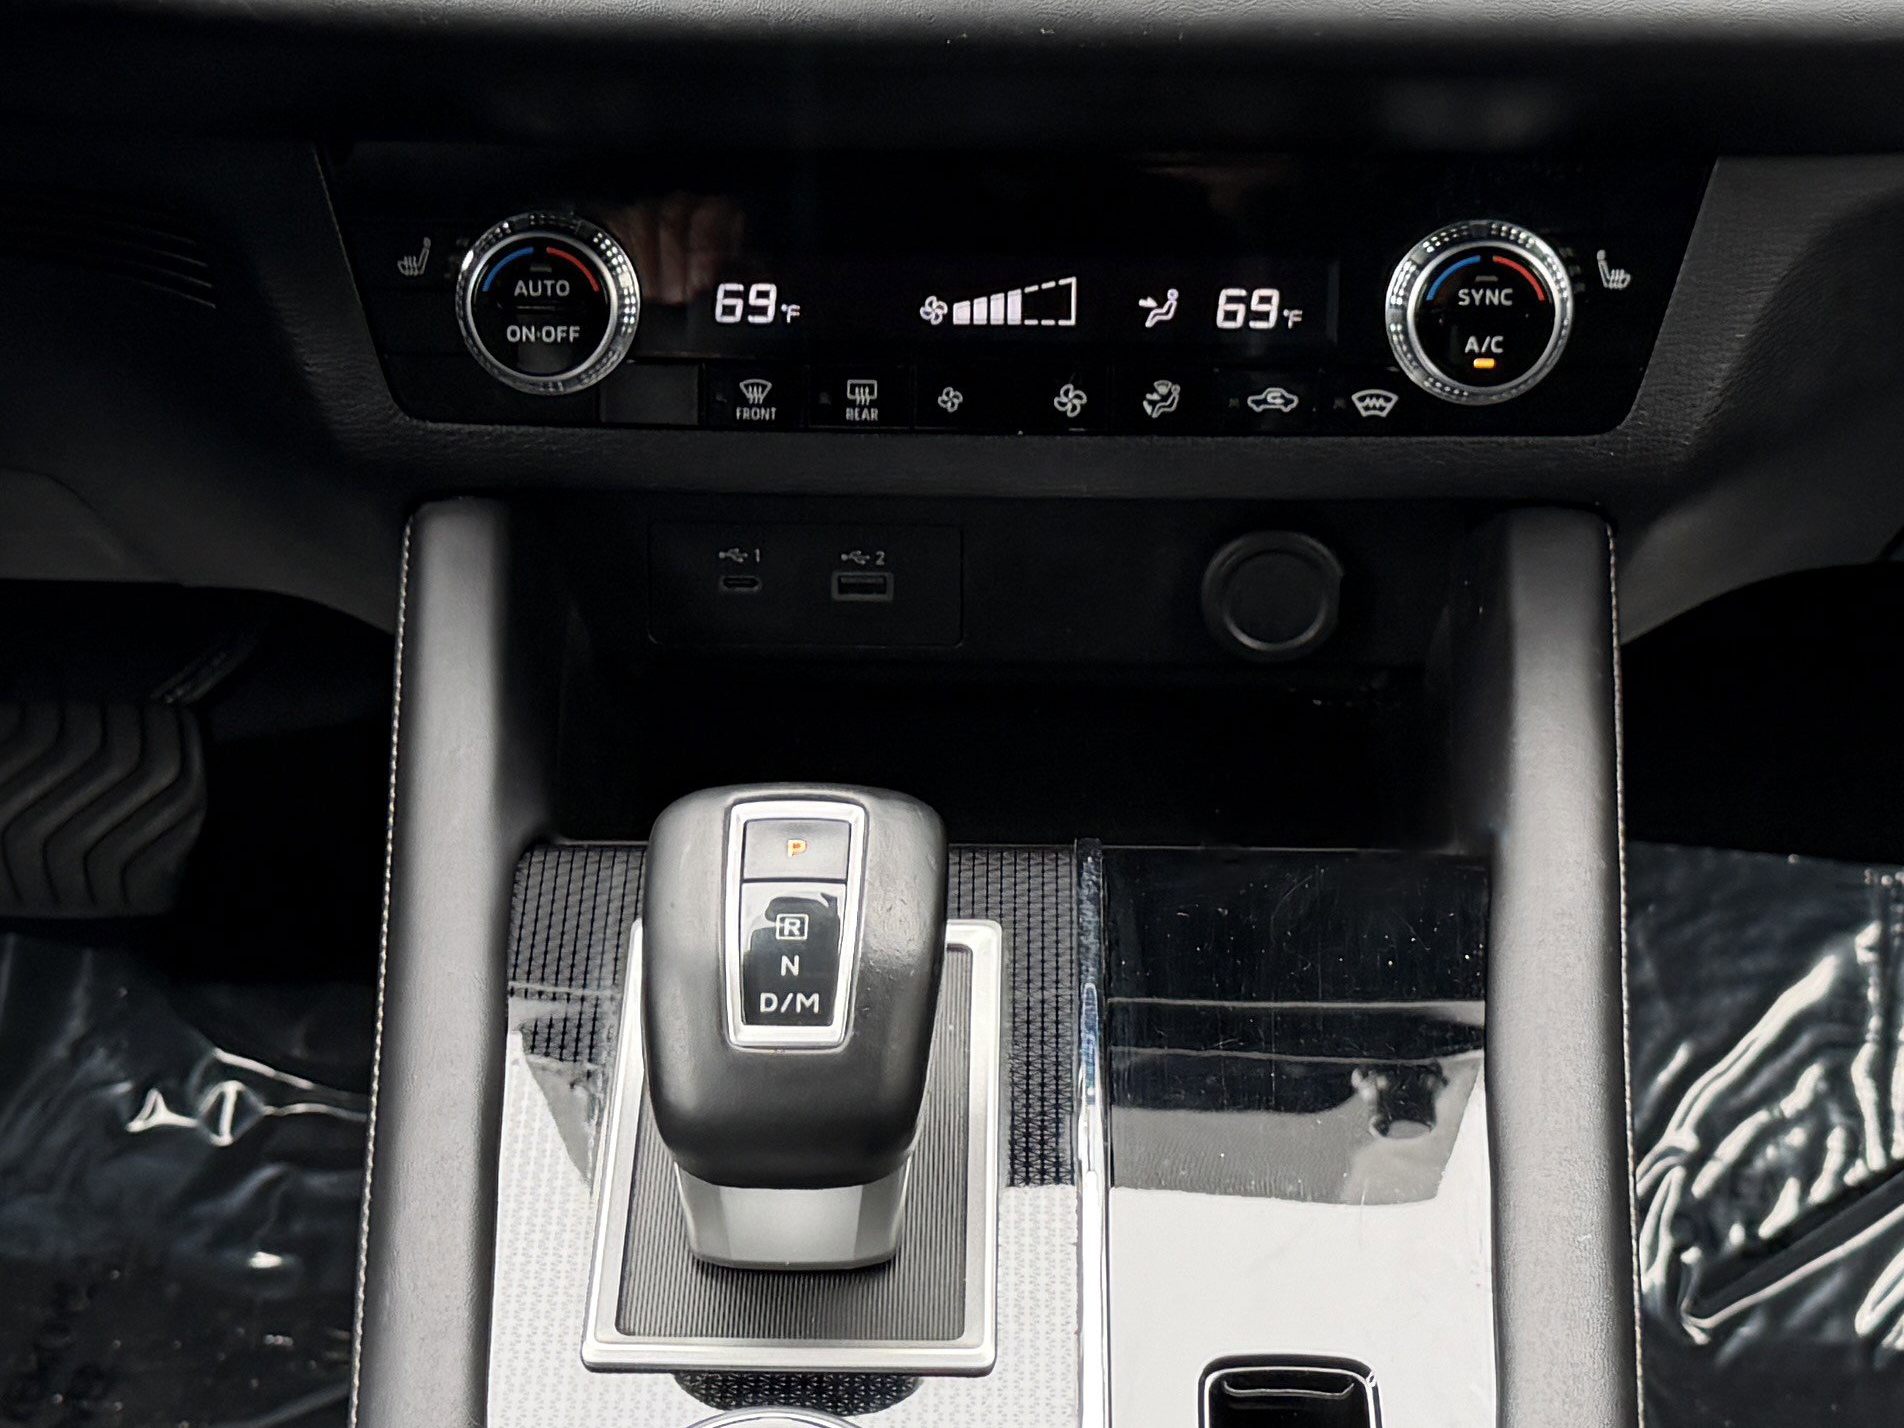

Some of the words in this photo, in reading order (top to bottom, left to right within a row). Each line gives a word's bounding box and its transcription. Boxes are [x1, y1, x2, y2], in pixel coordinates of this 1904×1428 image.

[514, 280, 571, 298] AUTO
[1458, 288, 1512, 306] SYNC
[1464, 336, 1504, 355] A/C
[736, 407, 776, 421] FRONT
[846, 407, 878, 421] REAR
[876, 551, 884, 564] 2
[786, 839, 807, 856] P
[784, 918, 801, 935] R
[781, 955, 799, 976] N
[759, 992, 819, 1013] D/M
